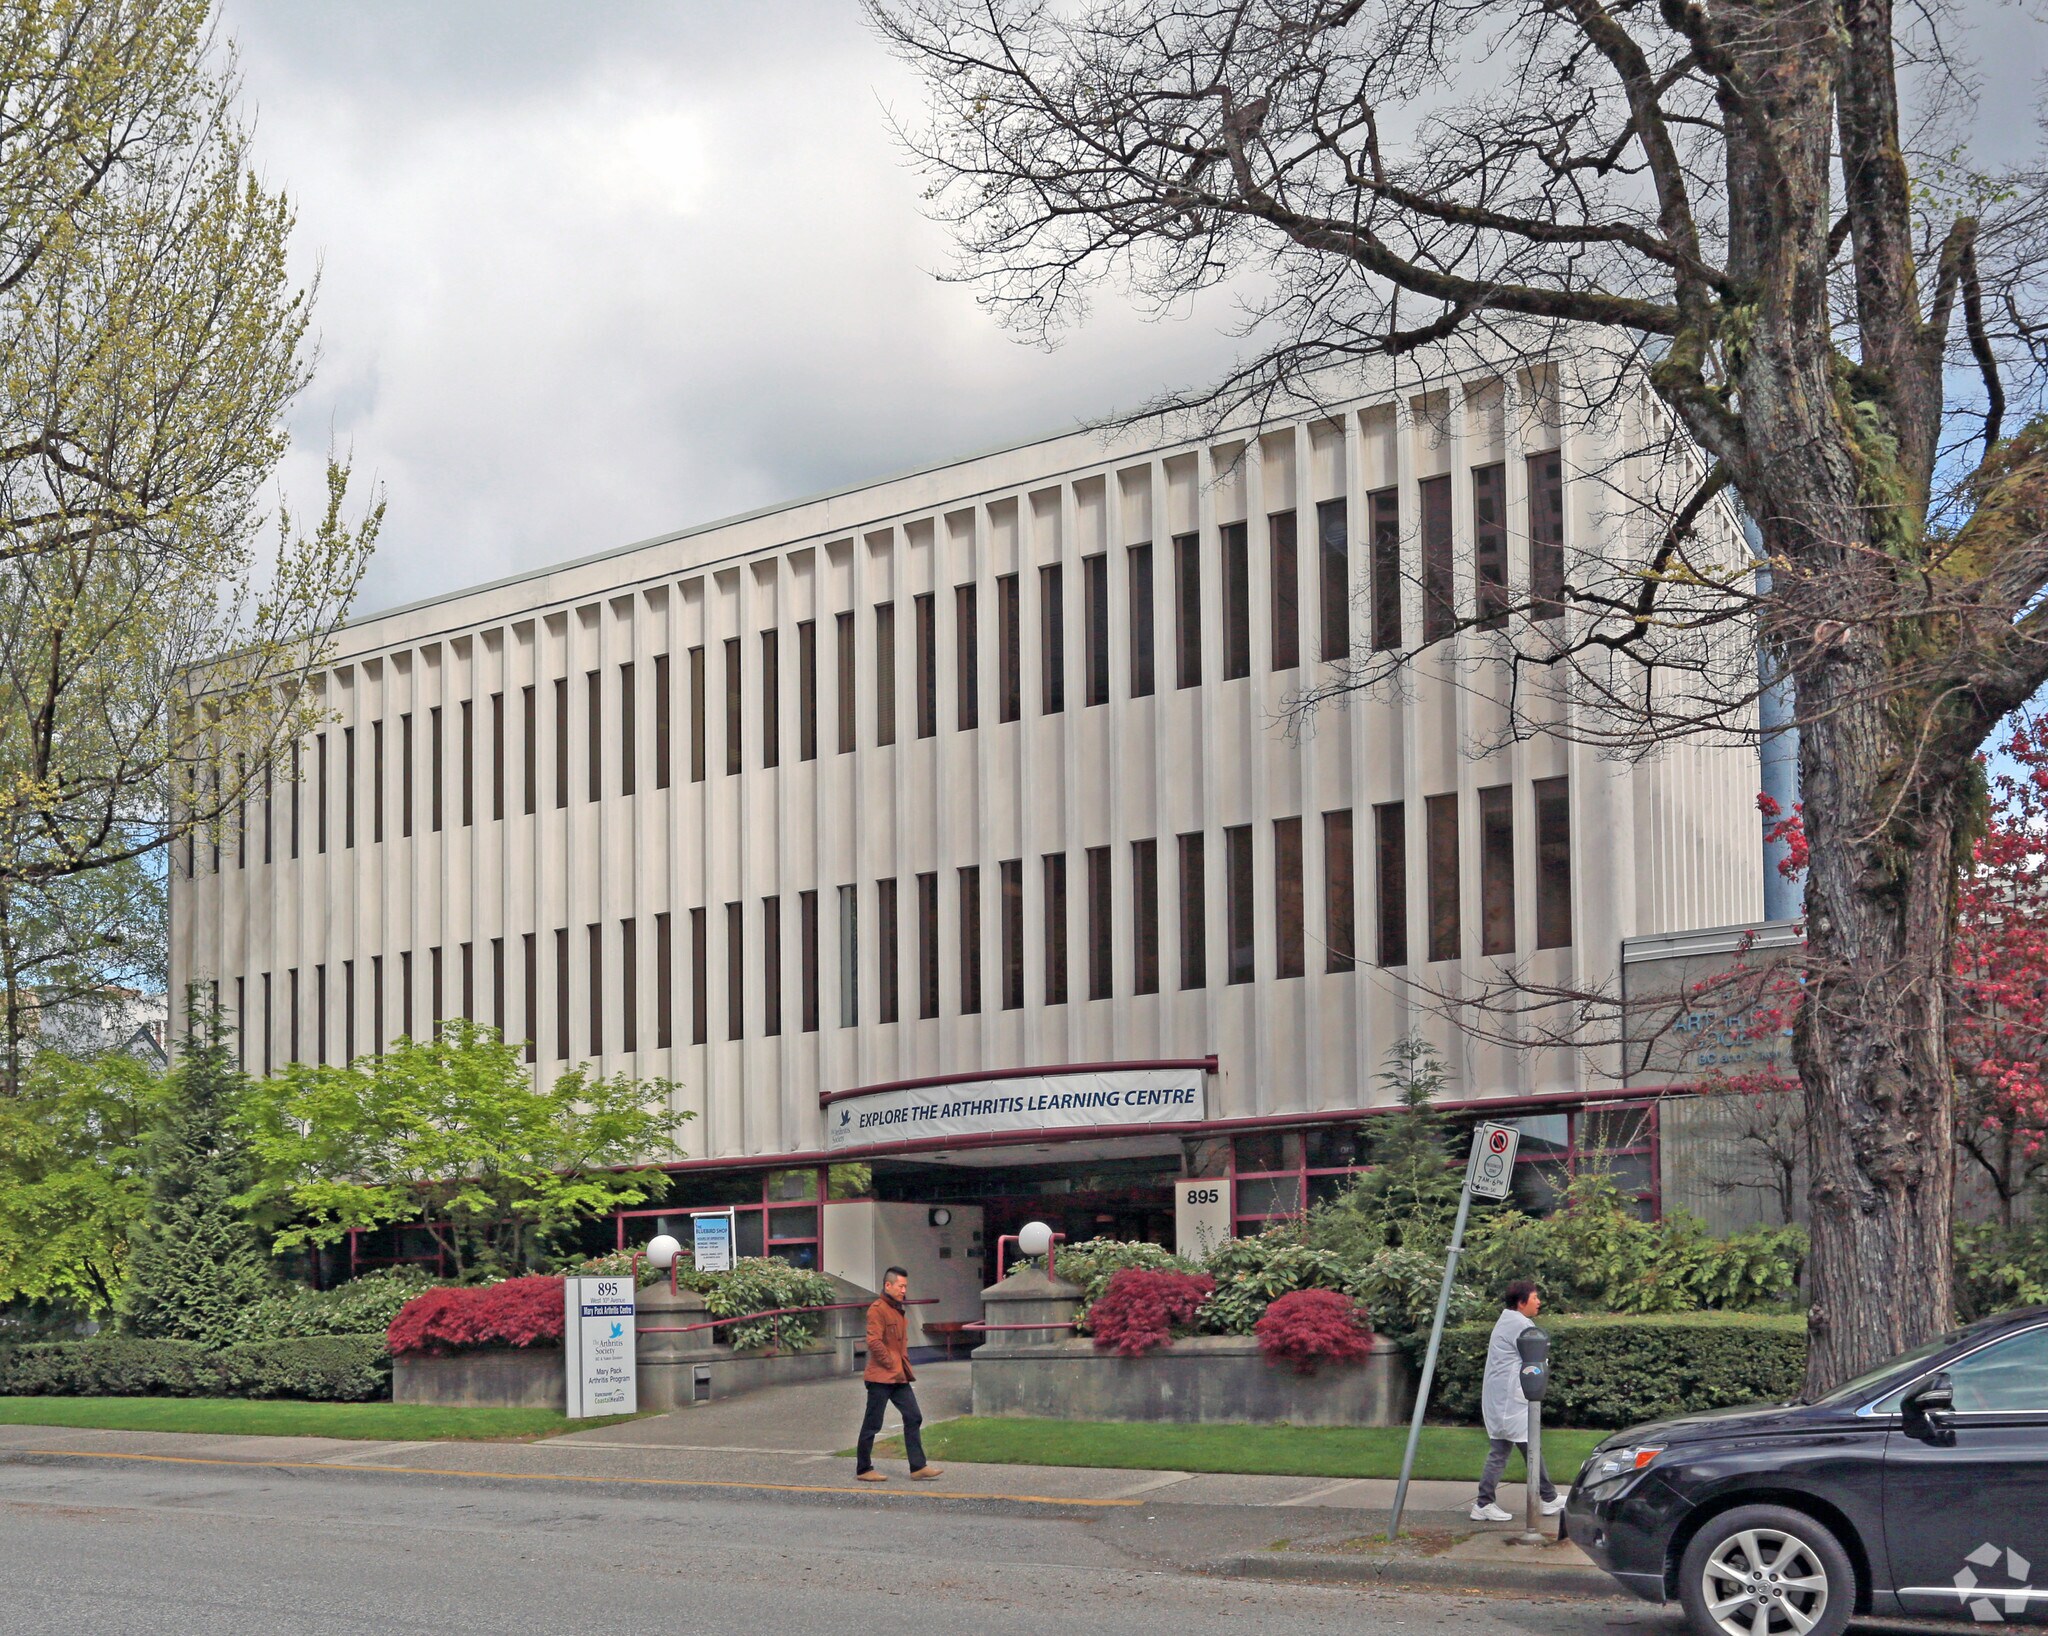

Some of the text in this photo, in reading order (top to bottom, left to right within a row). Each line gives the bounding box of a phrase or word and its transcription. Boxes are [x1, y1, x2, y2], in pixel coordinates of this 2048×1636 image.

[859, 1088, 1196, 1128] EXPLORE THE ARTHRITIS LEARNING CENTRE
[1187, 1189, 1219, 1205] 895
[597, 1282, 618, 1296] 895
[583, 1305, 632, 1317] Mary Pack Arthritis Centre
[600, 1339, 624, 1347] Arthritis
[595, 1346, 616, 1355] Society
[596, 1368, 609, 1376] Mary
[609, 1375, 631, 1384] Program
